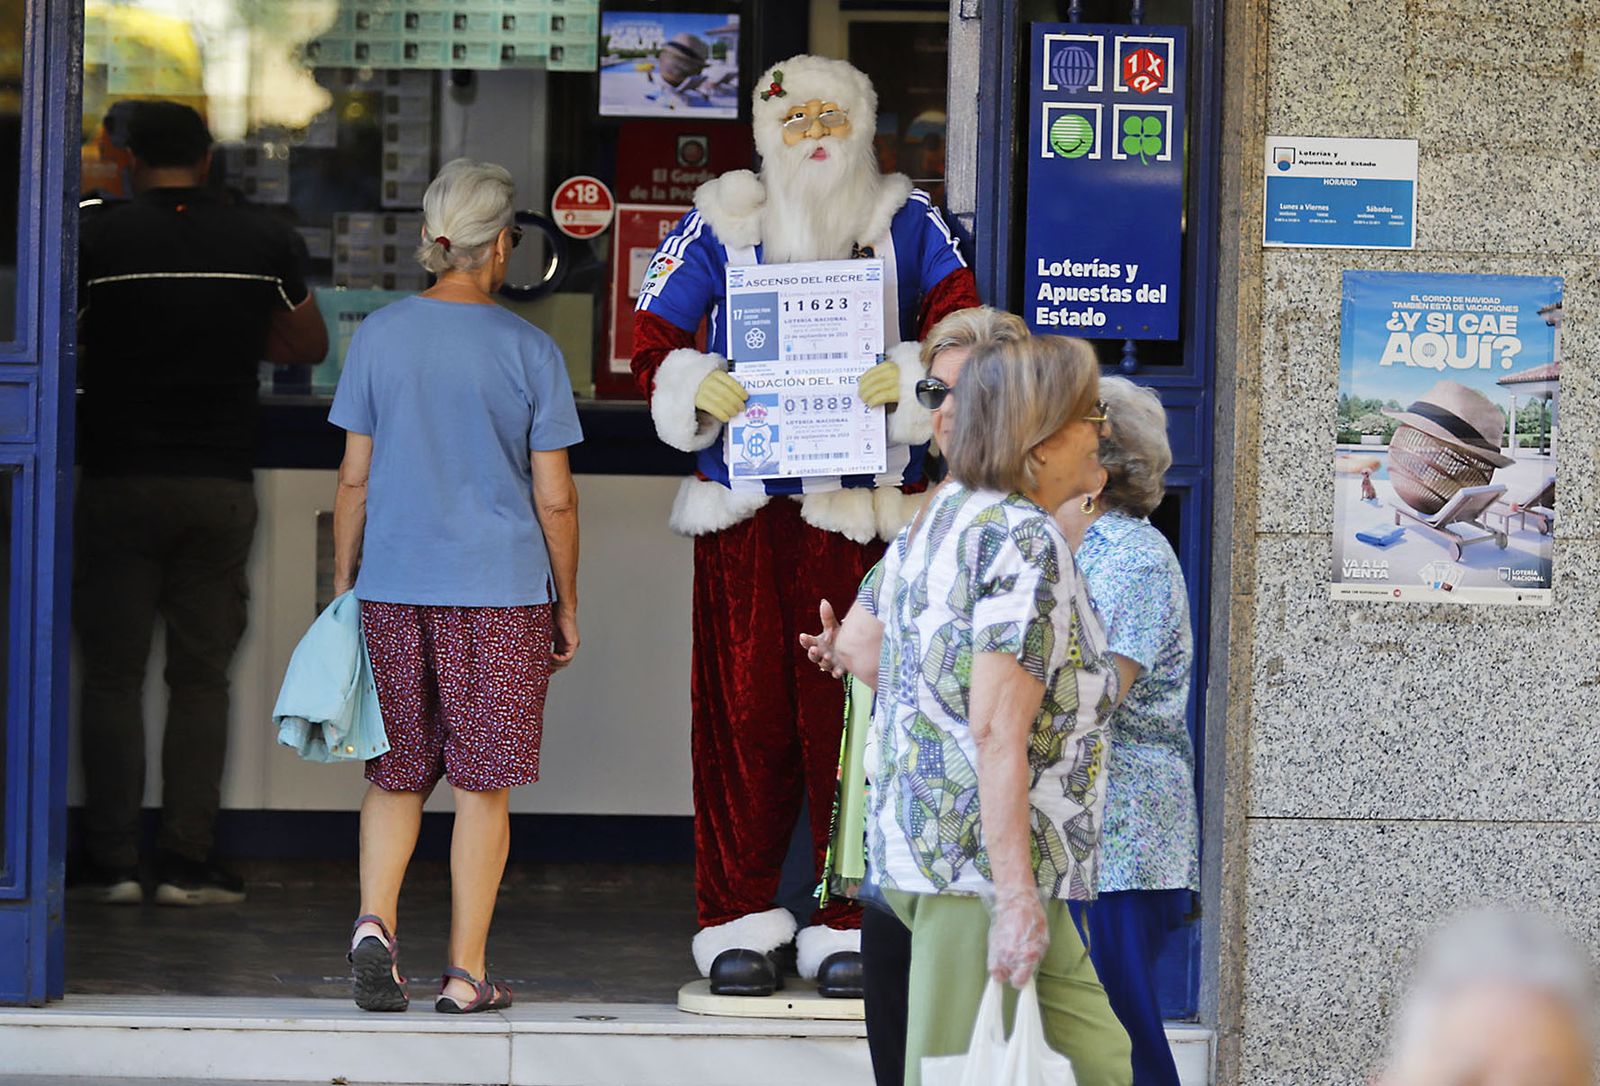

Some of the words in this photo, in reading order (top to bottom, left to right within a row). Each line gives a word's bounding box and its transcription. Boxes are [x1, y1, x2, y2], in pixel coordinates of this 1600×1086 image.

[1128, 54, 1138, 74] 1
[1147, 52, 1161, 78] X
[1133, 75, 1158, 92] 2
[652, 168, 668, 182] El
[1323, 178, 1358, 187] HORARIO
[566, 183, 599, 204] +18
[630, 185, 648, 200] de
[652, 185, 666, 199] la
[670, 186, 695, 200] Pri
[1037, 258, 1121, 278] Loterías
[1125, 264, 1139, 283] y
[745, 277, 798, 287] ASCENSO
[801, 276, 822, 285] DEL
[826, 274, 864, 283] RECRE
[1037, 282, 1133, 306] Apuestas
[1135, 284, 1168, 304] del
[1422, 295, 1452, 303] GORDO
[783, 298, 848, 312] 11623
[1392, 301, 1429, 310] TAMBIÉN
[1429, 302, 1452, 310] ESTÁ
[1465, 304, 1519, 312] VACACIONES
[733, 309, 742, 320] 17
[1036, 307, 1107, 327] Estado
[1386, 311, 1422, 331] ¿Y
[1425, 312, 1454, 333] SI
[1458, 313, 1518, 335] CAE
[1379, 332, 1522, 372] AQUÍ?
[808, 376, 834, 386] DEL
[784, 396, 852, 412] 01889
[1342, 558, 1361, 568] YA
[1361, 559, 1371, 568] A
[1372, 560, 1389, 569] LA
[1342, 568, 1390, 579] VENTA
